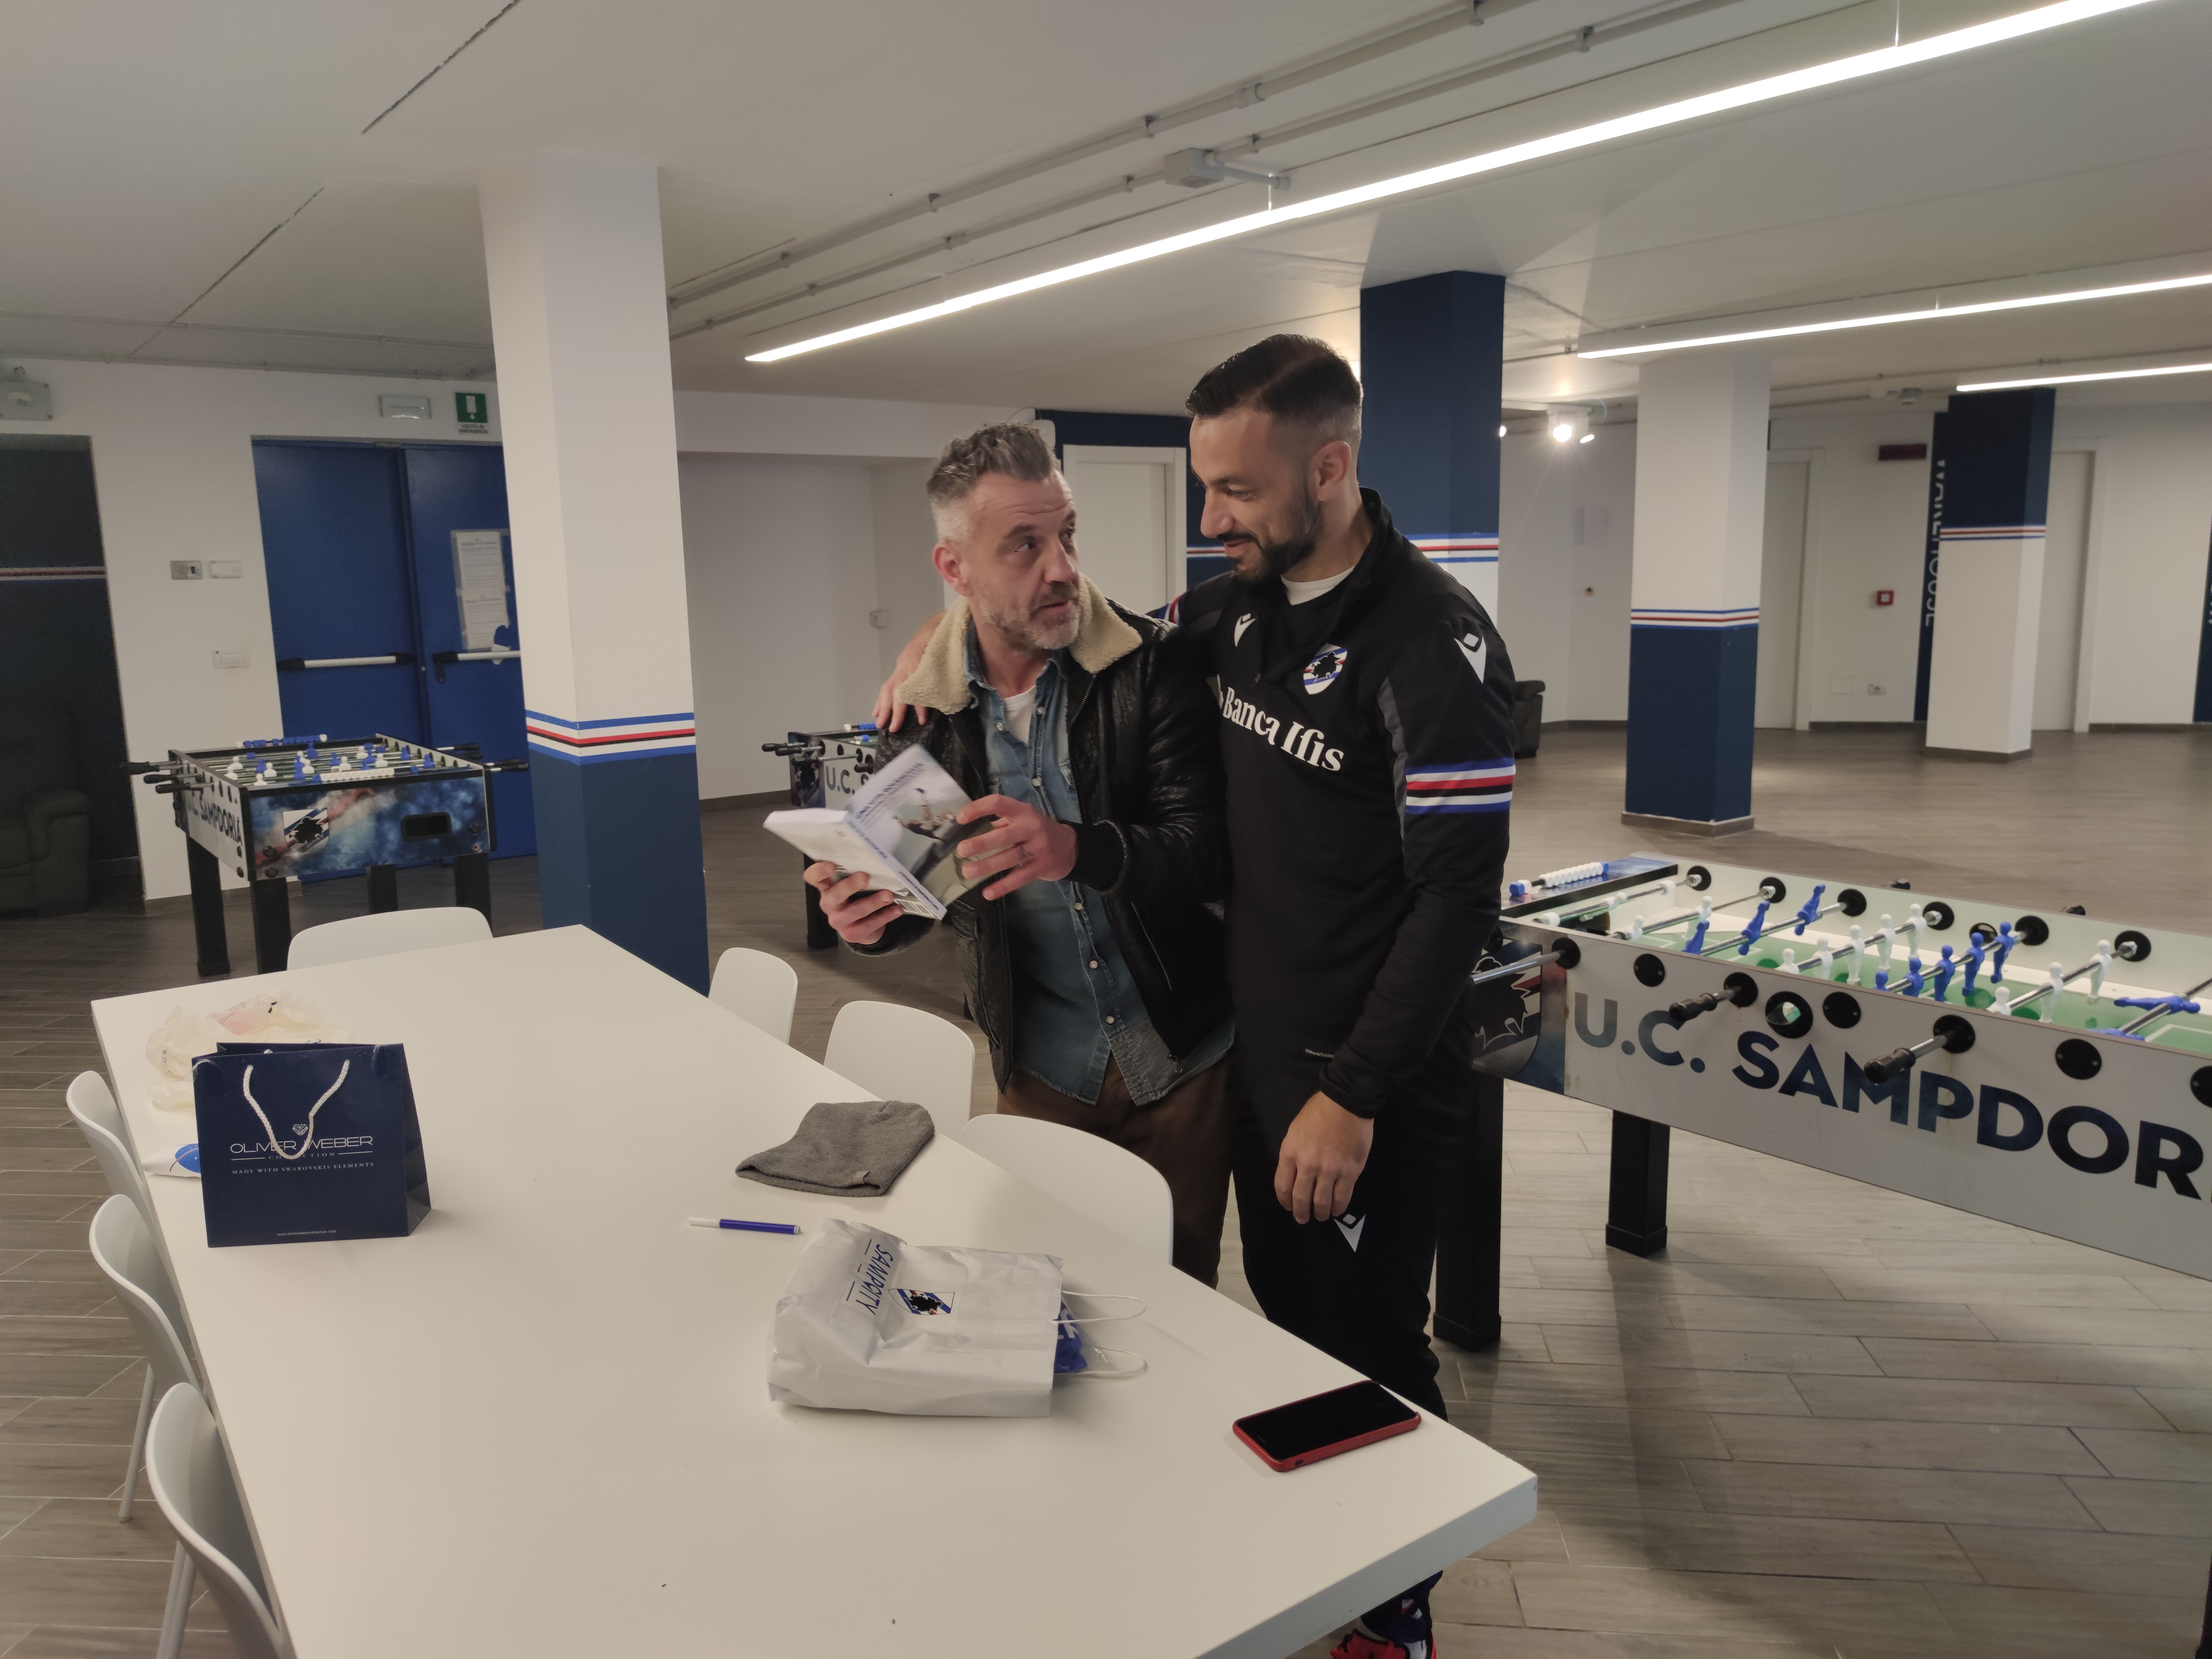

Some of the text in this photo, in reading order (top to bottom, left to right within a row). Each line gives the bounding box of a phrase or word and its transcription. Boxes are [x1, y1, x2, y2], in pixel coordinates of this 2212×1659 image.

[1222, 686, 1344, 771] Banca Ifis
[826, 766, 855, 795] U.C.
[1574, 991, 2212, 1203] U.C. SAMPDOR
[230, 1136, 373, 1153] OLIVER WEBER
[855, 1244, 893, 1316] SAMPCITY
